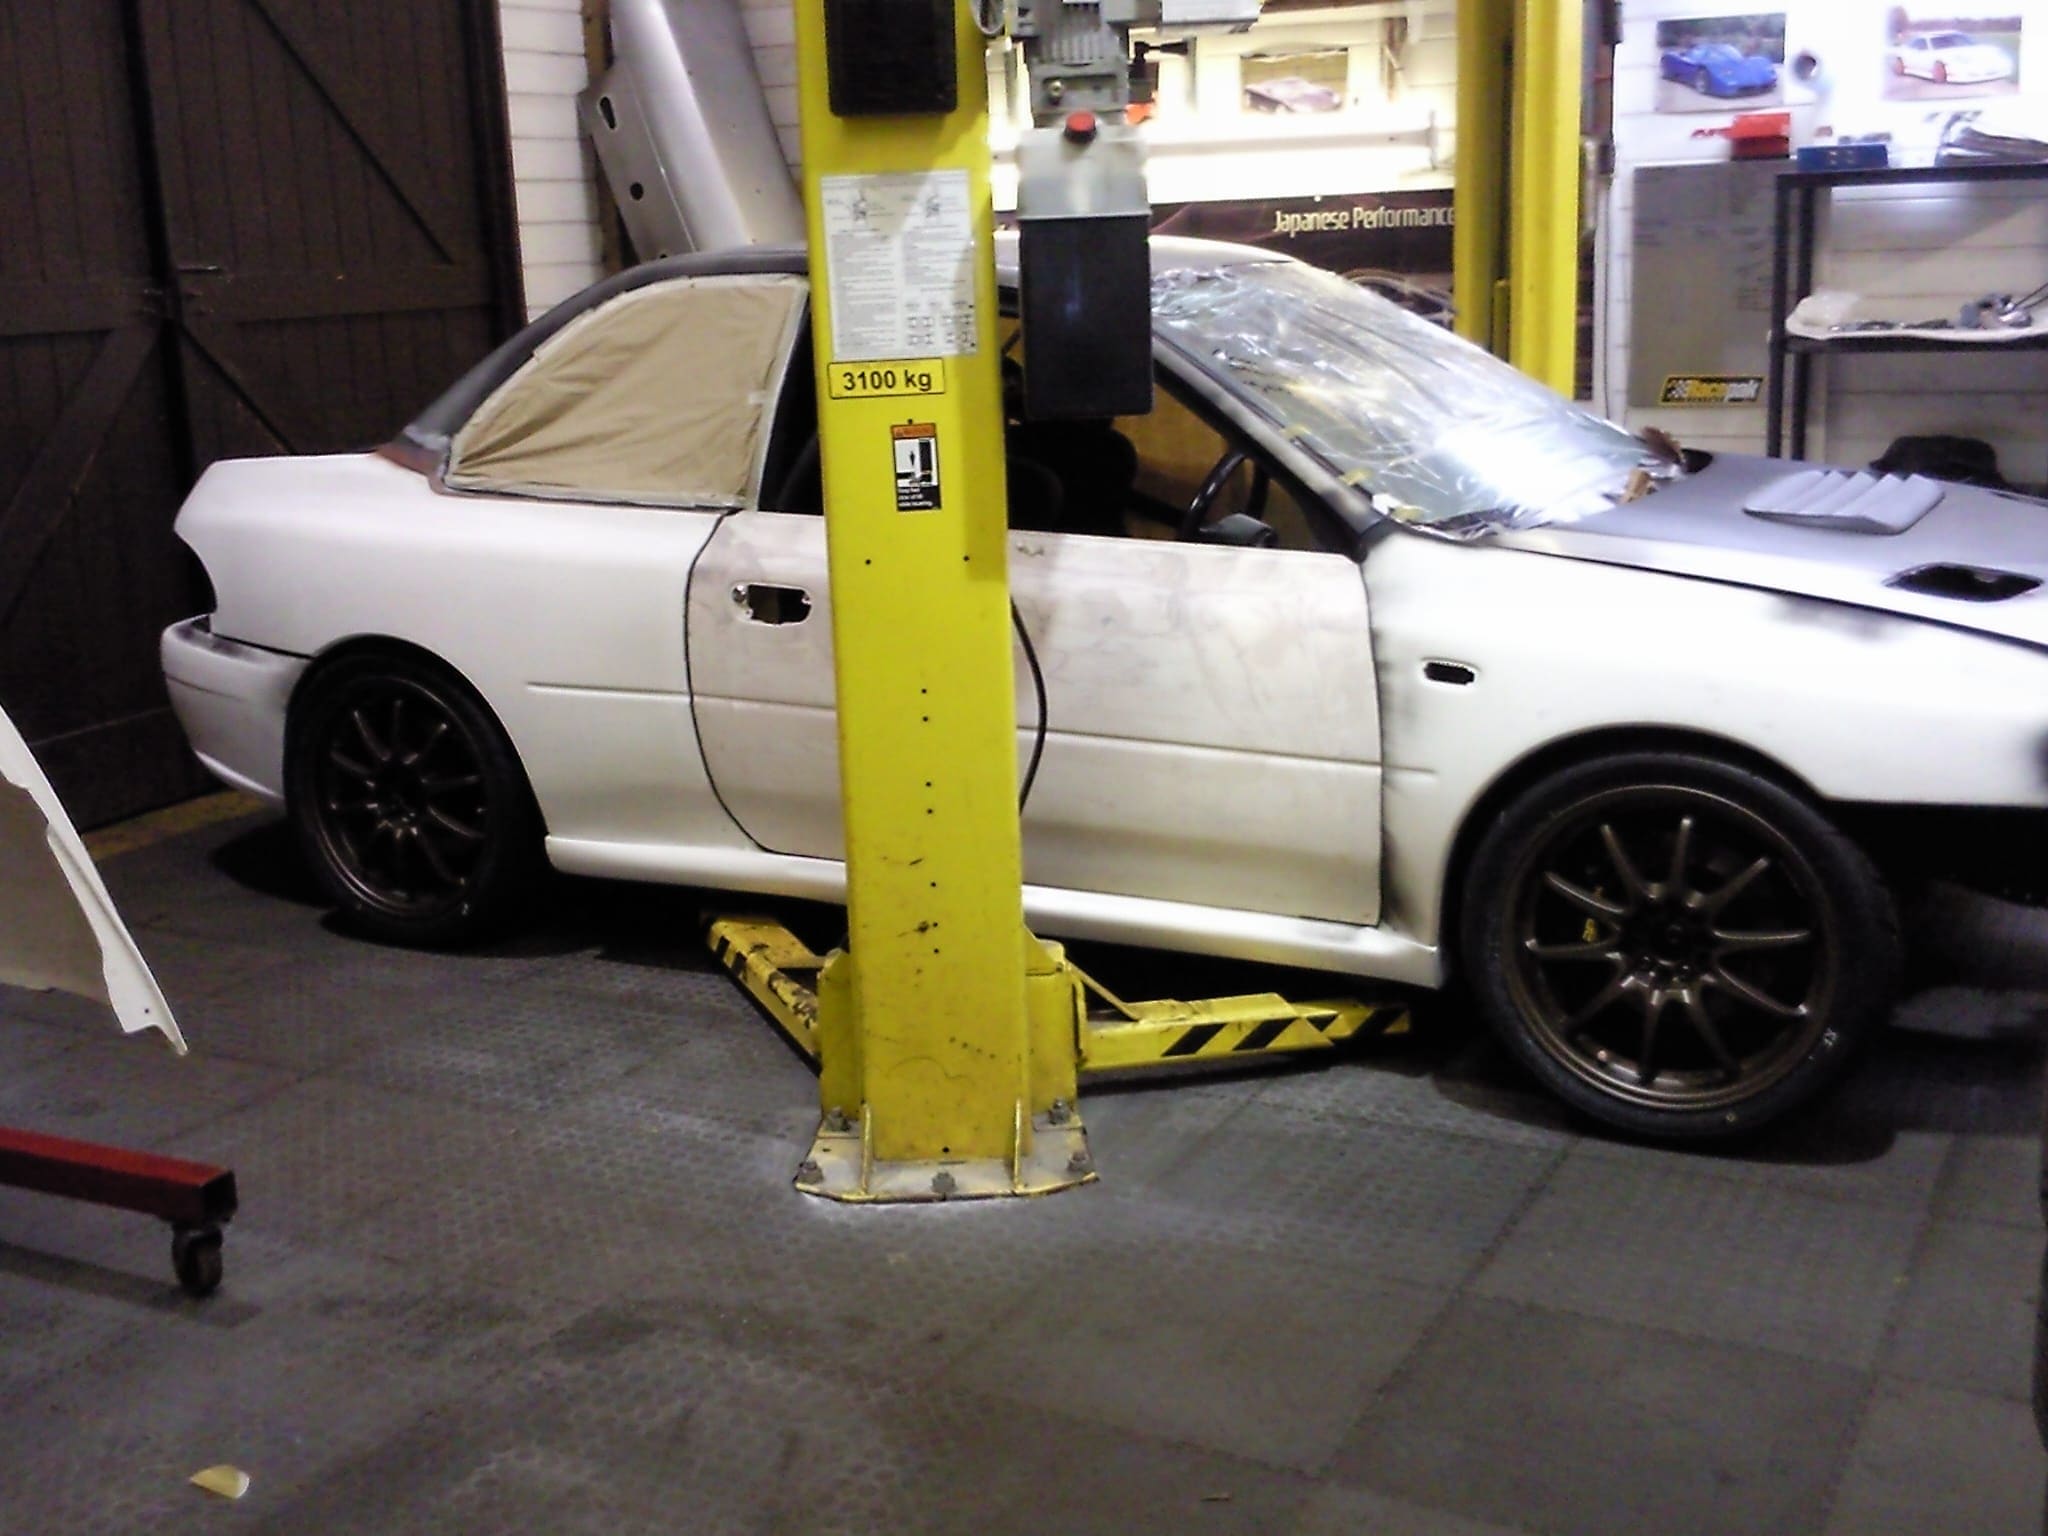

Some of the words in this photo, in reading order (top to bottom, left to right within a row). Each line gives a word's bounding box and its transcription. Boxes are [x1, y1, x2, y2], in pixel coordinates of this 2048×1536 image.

[1273, 210, 1350, 237] Japanese
[842, 370, 896, 391] 3100
[904, 369, 932, 392] kg
